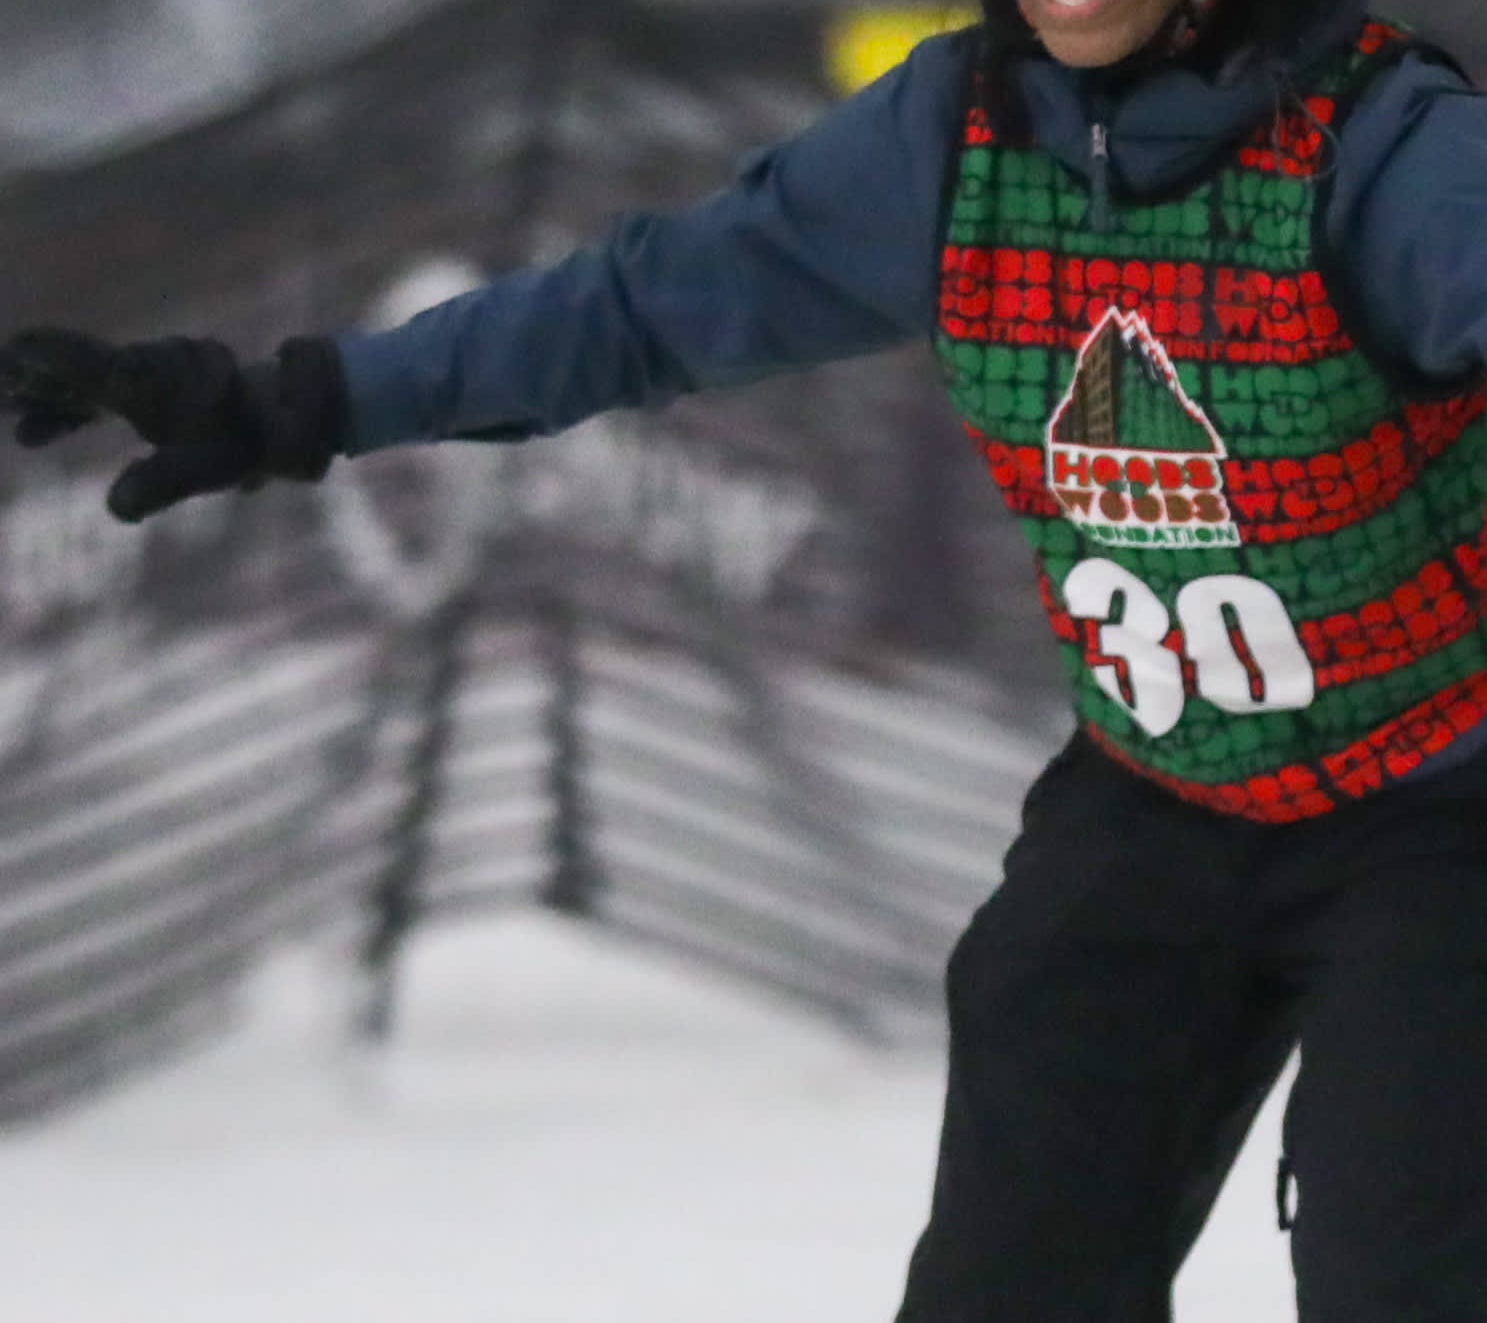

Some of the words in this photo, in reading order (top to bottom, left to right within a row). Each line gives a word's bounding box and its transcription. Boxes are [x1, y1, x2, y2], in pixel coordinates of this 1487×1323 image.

[1053, 451, 1218, 490] HOODS
[1054, 488, 1226, 523] WOODS
[1064, 557, 1314, 737] 30
